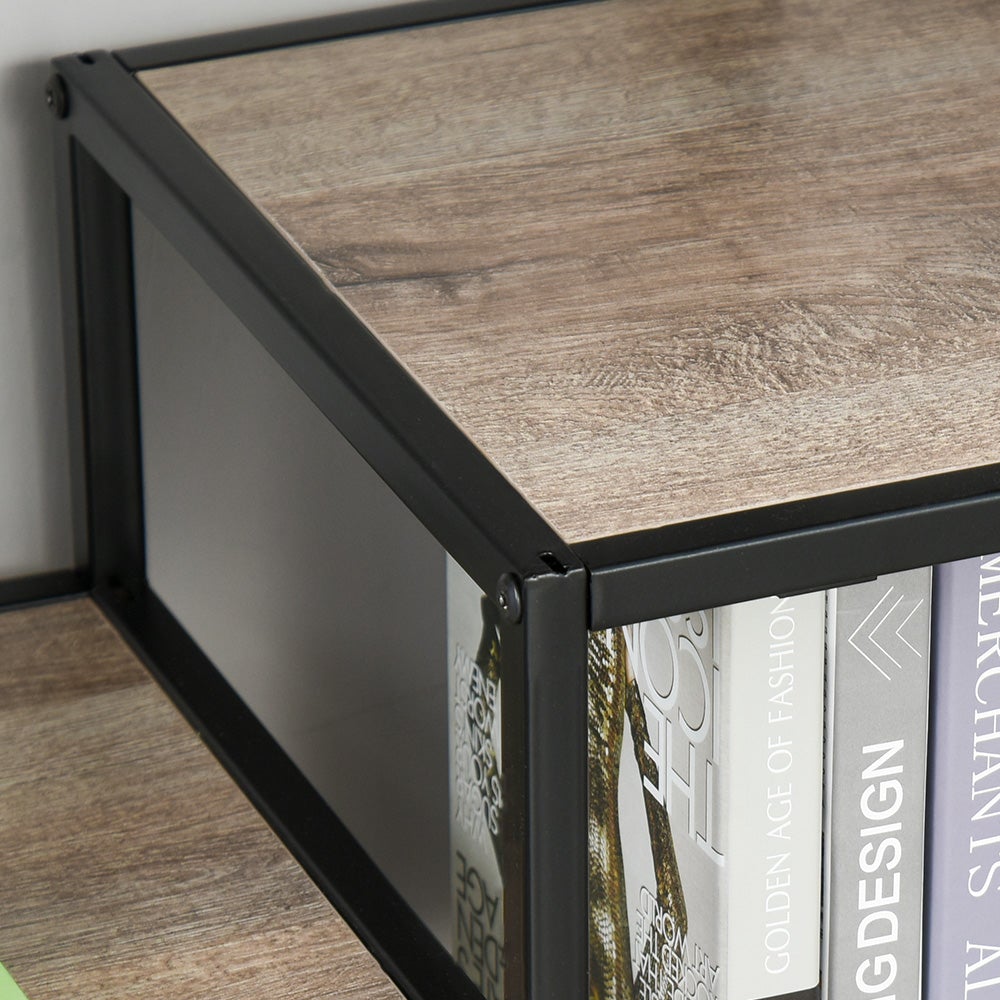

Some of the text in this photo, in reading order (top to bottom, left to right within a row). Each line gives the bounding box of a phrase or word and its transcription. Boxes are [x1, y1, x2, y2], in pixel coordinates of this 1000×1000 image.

[644, 693, 724, 867] THE
[767, 735, 793, 774] OF
[766, 782, 792, 841] AGE
[635, 909, 660, 962] THE
[639, 885, 720, 990] ART WORLD
[764, 854, 791, 975] GOLDEN
[632, 937, 663, 998] THAT
